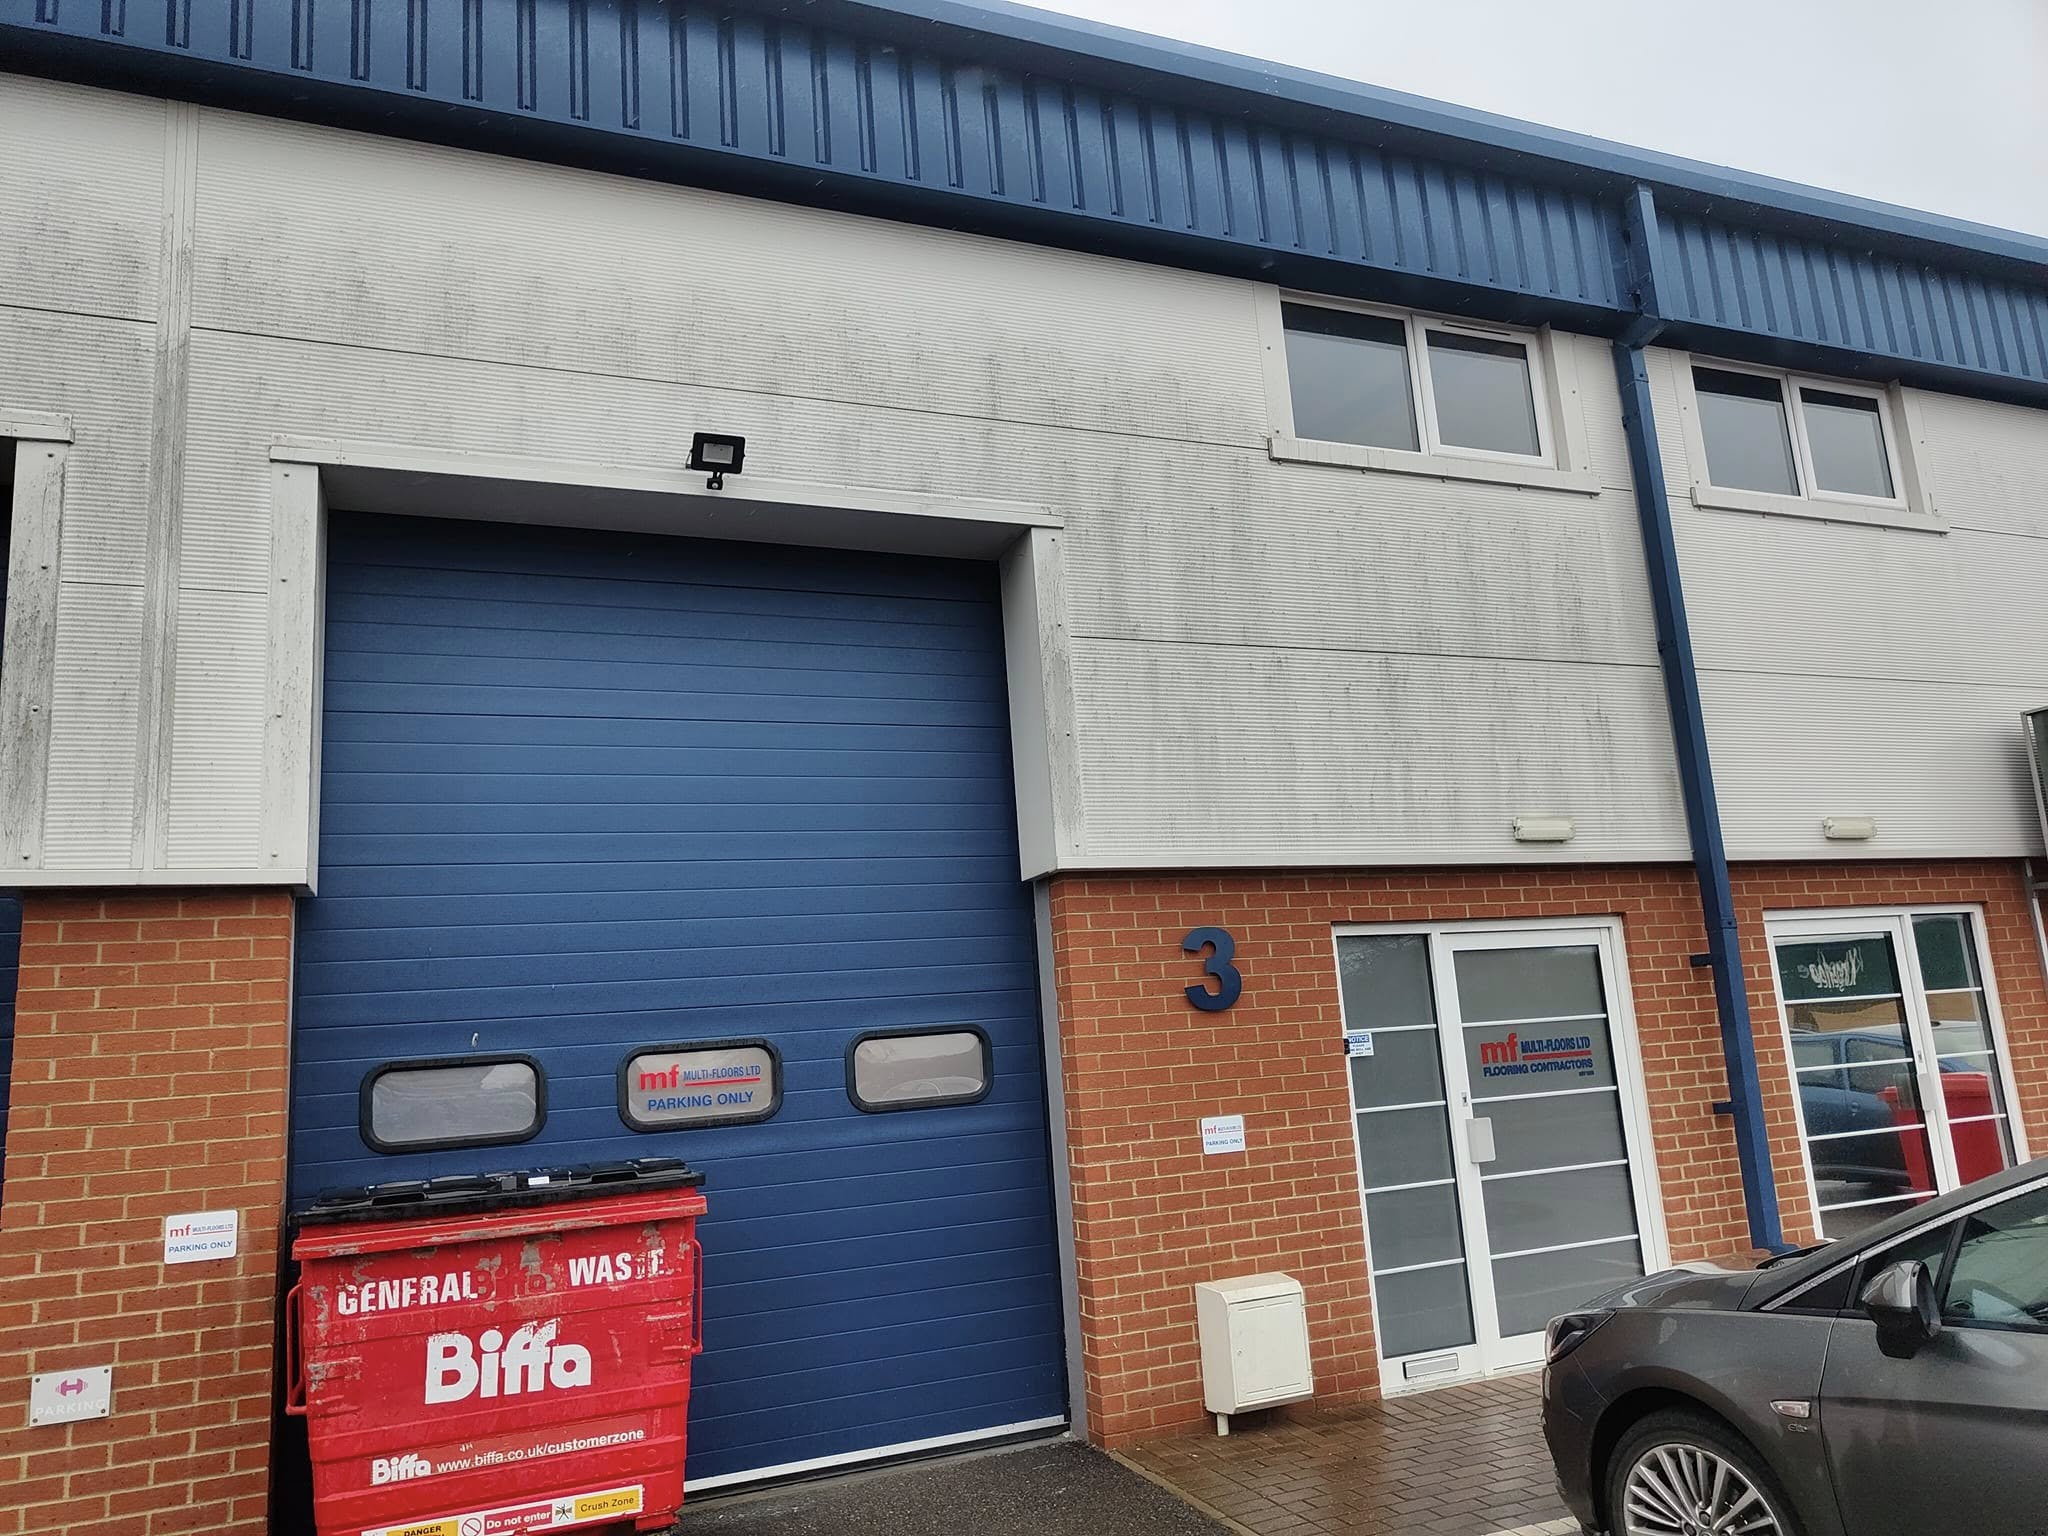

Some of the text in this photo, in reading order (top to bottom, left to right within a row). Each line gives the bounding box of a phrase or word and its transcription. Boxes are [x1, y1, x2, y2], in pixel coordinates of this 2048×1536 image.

[1182, 926, 1242, 1012] 3
[1480, 1033, 1590, 1064] mf MULTI-FLOORS LTD
[639, 1064, 761, 1090] mf MULTI-FLOORS LTD
[1483, 1063, 1528, 1077] FLOORING
[1530, 1059, 1593, 1073] CONTRACTORS
[648, 1091, 754, 1111] PARKING ONLY
[169, 1224, 191, 1238] mf
[168, 1240, 233, 1253] PARKING ONLY
[337, 1248, 665, 1315] GENERAL WASE
[425, 1318, 592, 1404] Biffa
[35, 1400, 106, 1417] PARKING
[371, 1428, 645, 1485] Biffa www.biffa.co.uk/customerzone
[580, 1496, 635, 1512] Crush Zone
[486, 1511, 551, 1530] Do not enter
[403, 1525, 442, 1536] DANGER
